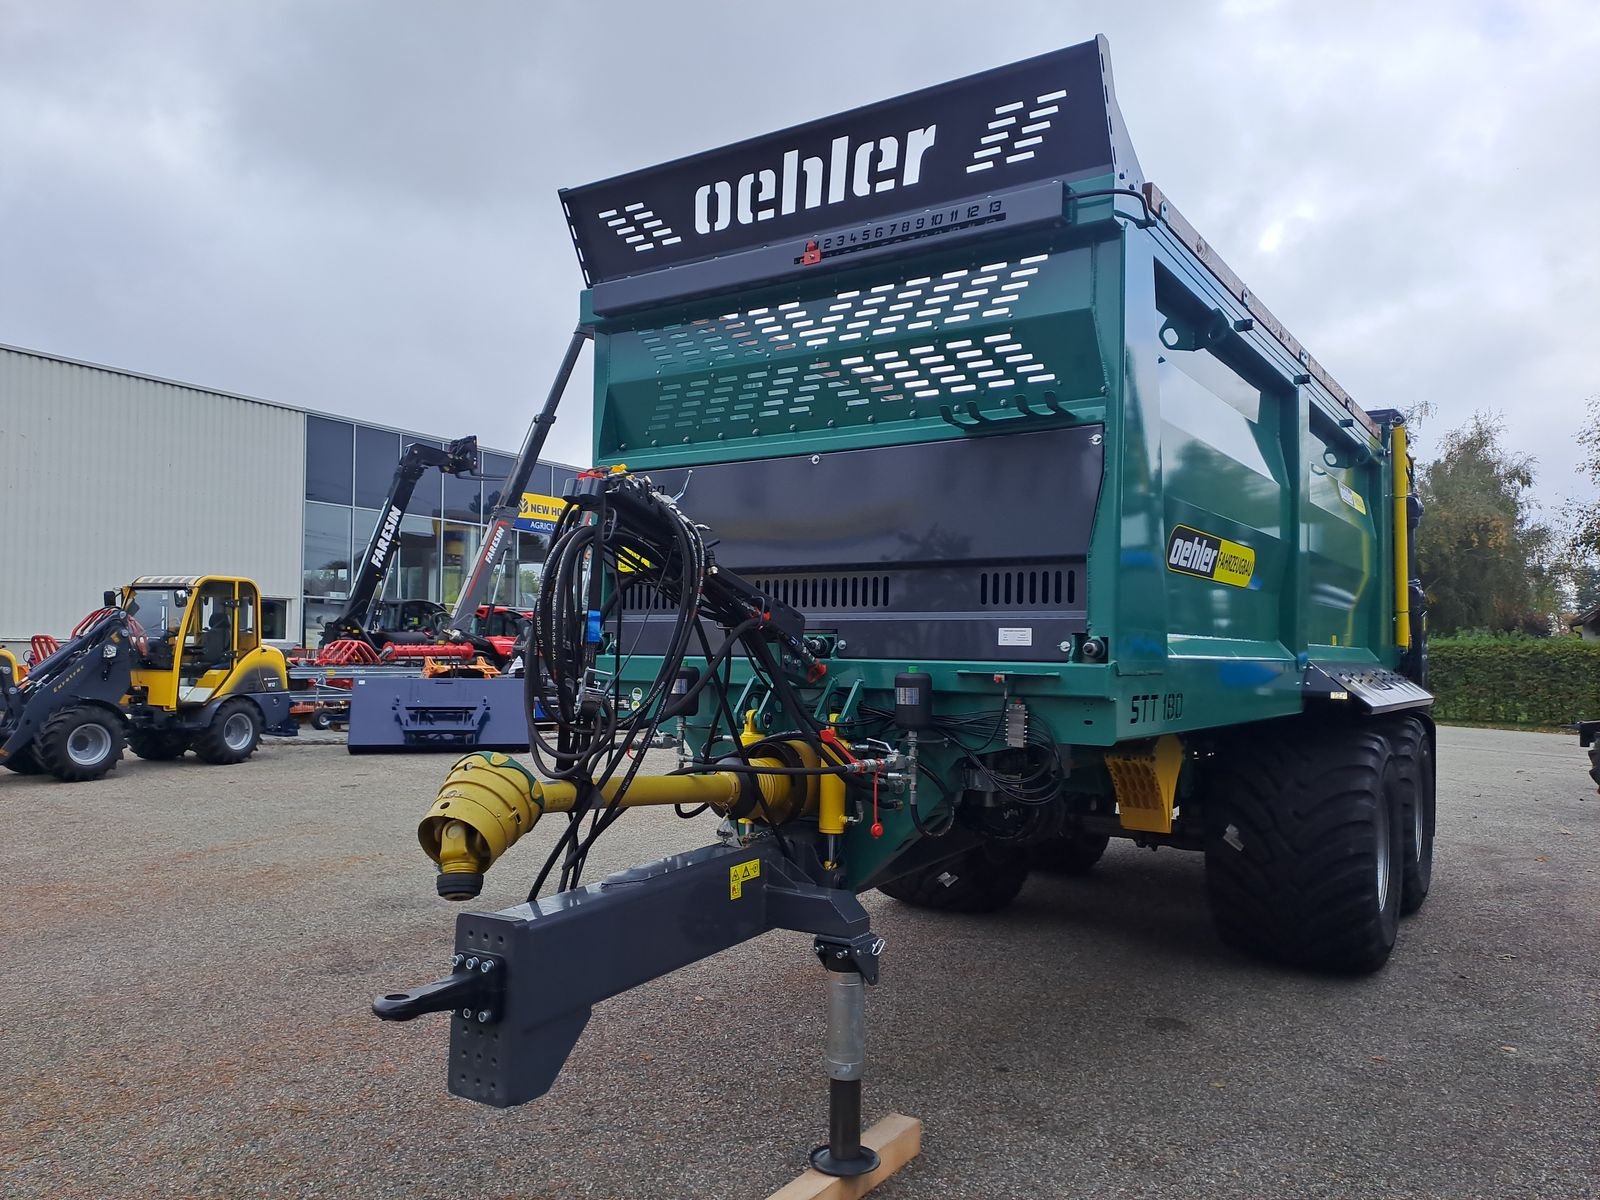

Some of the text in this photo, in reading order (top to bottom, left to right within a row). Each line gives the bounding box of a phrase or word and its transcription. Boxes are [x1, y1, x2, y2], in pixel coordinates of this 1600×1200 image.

[694, 124, 937, 235] oehler
[823, 238, 832, 250] 2
[836, 235, 845, 247] 3
[849, 232, 857, 243] 4
[861, 229, 871, 241] 5
[874, 226, 884, 239] 6
[889, 223, 898, 235] 7
[901, 221, 911, 233] 8
[915, 217, 925, 230] 9
[931, 213, 944, 226] 10
[950, 209, 959, 222] 11
[967, 205, 980, 219] 12
[989, 200, 1002, 214] 13
[530, 503, 550, 515] NEW
[370, 504, 402, 569] FARESIN
[484, 526, 506, 564] FARESIN
[1168, 536, 1219, 573] oehler
[1130, 693, 1184, 725] STT 180
